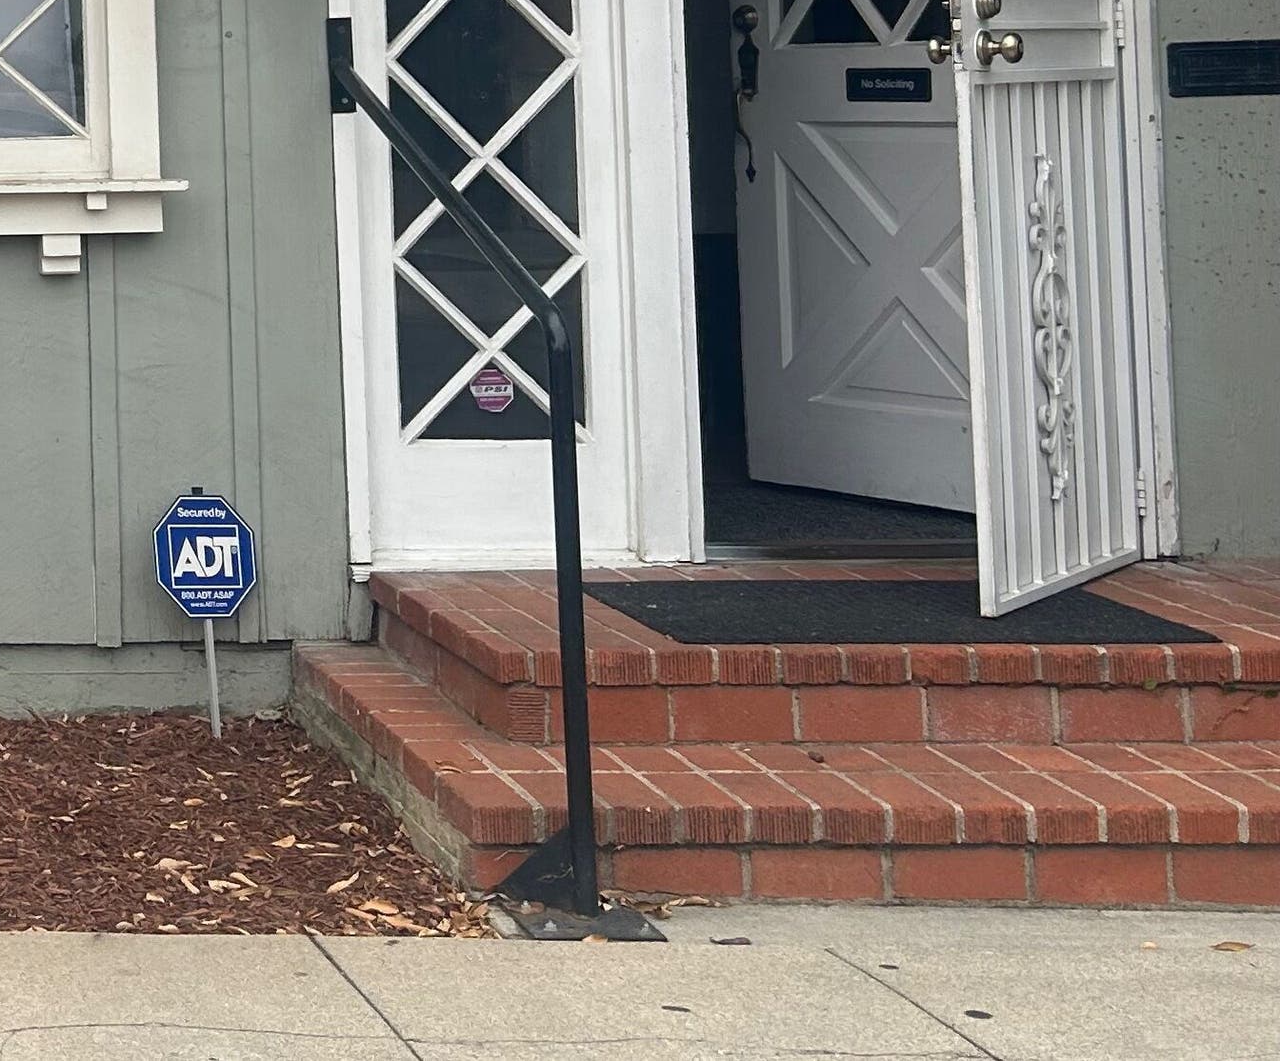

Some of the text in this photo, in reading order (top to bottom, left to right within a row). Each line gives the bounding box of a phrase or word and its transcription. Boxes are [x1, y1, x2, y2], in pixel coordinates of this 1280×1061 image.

[861, 78, 915, 92] No Soliciting
[177, 507, 227, 520] Secured by
[173, 535, 239, 578] ADT
[181, 591, 234, 600] 800.ADT.ASAP
